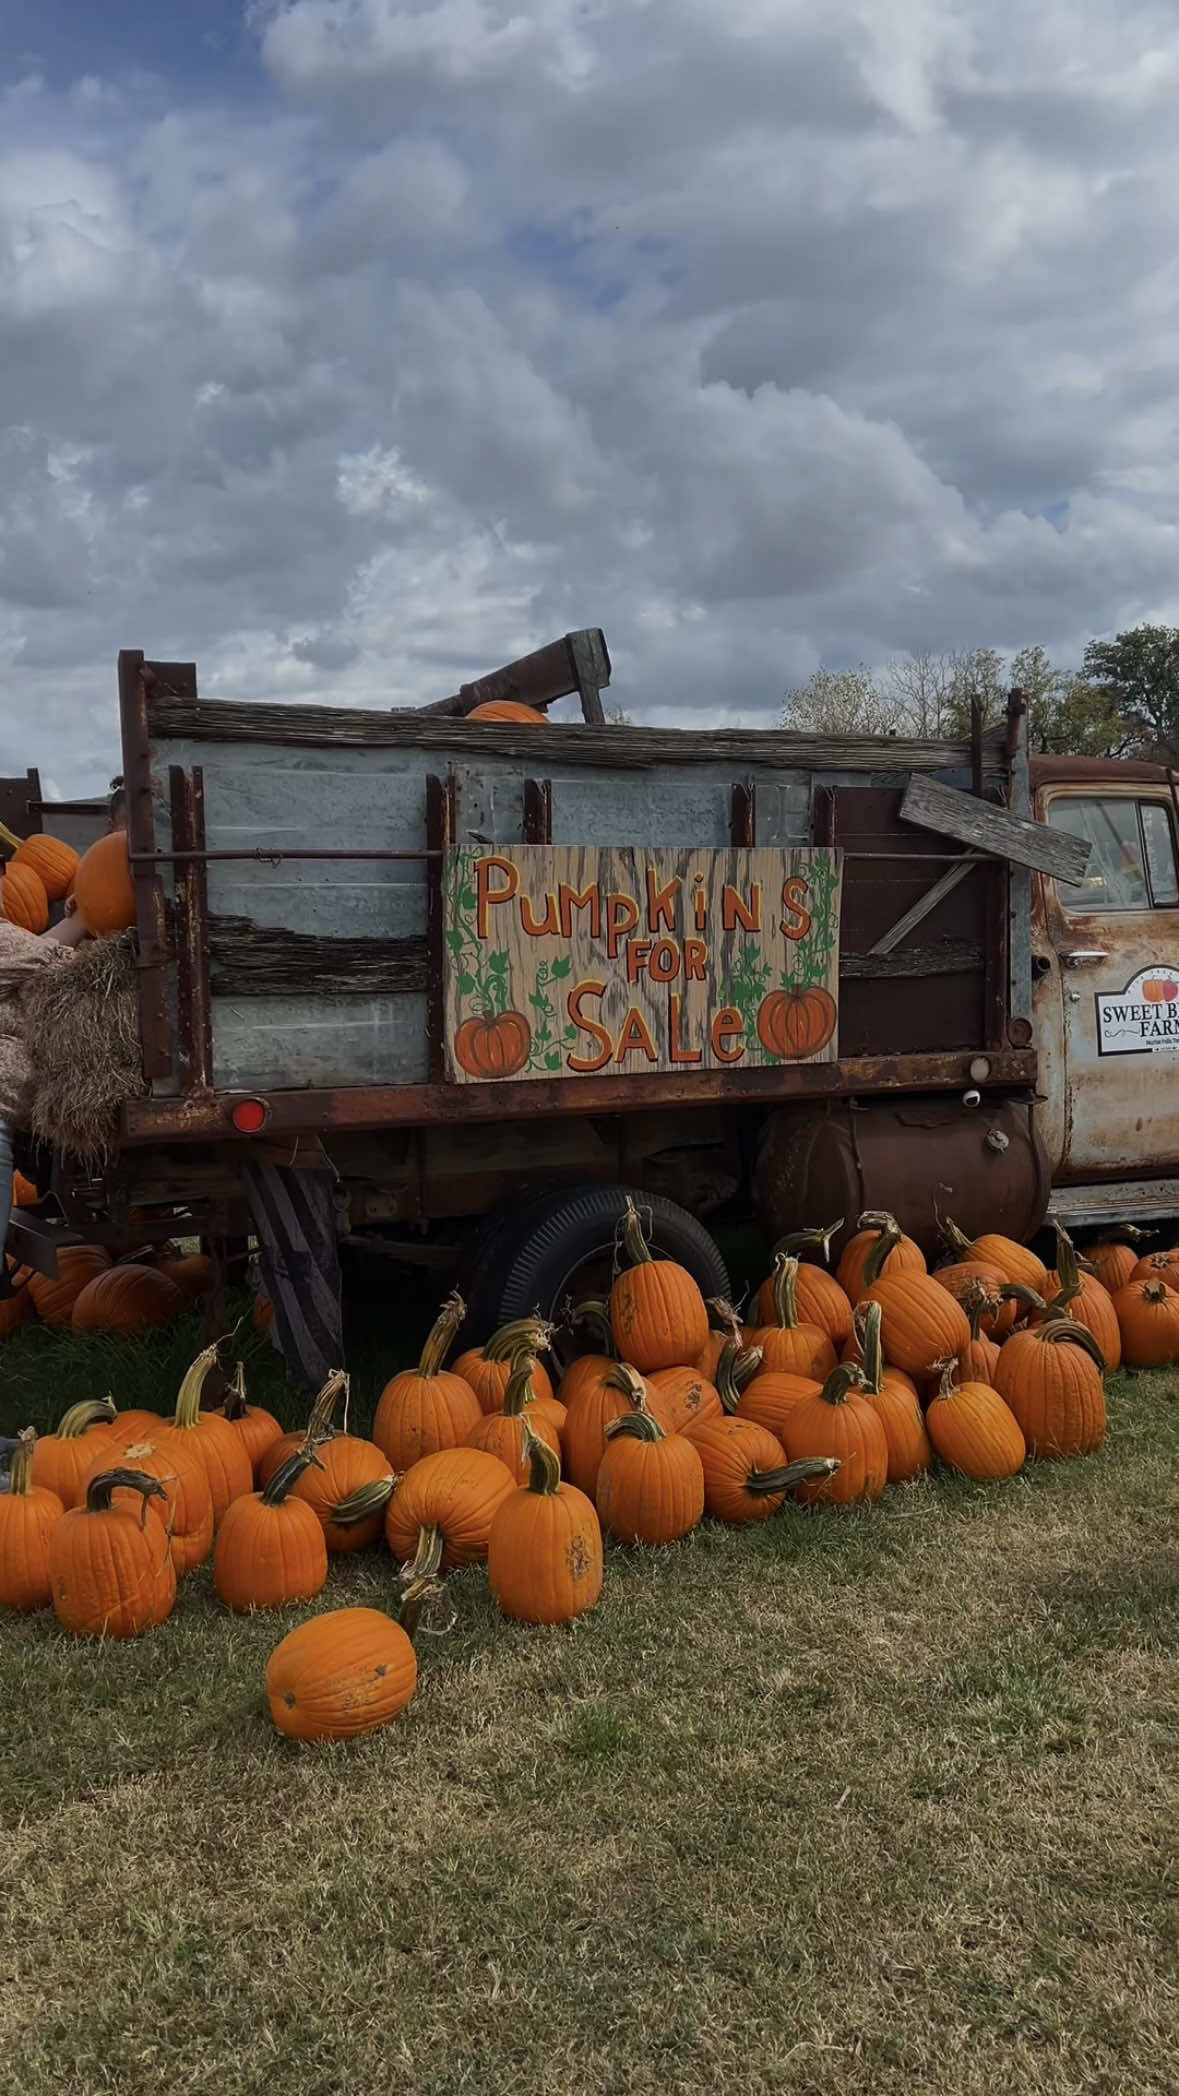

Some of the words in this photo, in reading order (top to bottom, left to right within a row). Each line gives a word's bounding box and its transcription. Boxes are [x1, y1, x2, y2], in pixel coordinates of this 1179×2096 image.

[626, 936, 709, 984] FOR
[1103, 1004, 1162, 1023] SWEET
[1167, 1002, 1179, 1019] B
